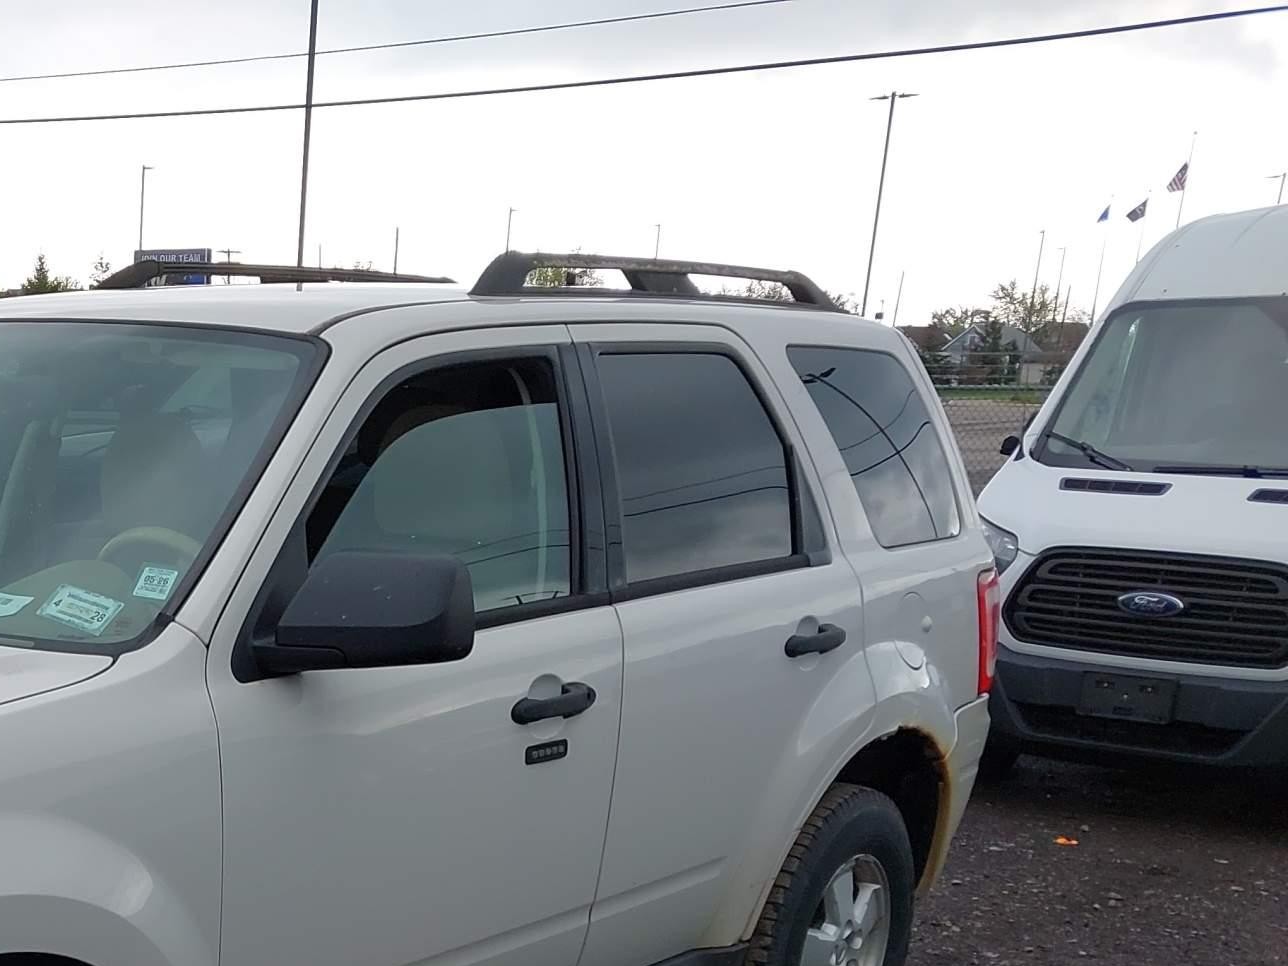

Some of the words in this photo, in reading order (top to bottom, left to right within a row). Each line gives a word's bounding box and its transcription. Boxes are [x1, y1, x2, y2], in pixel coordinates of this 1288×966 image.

[159, 254, 178, 262] OUR
[179, 253, 201, 262] TEAM
[53, 599, 63, 607] 4
